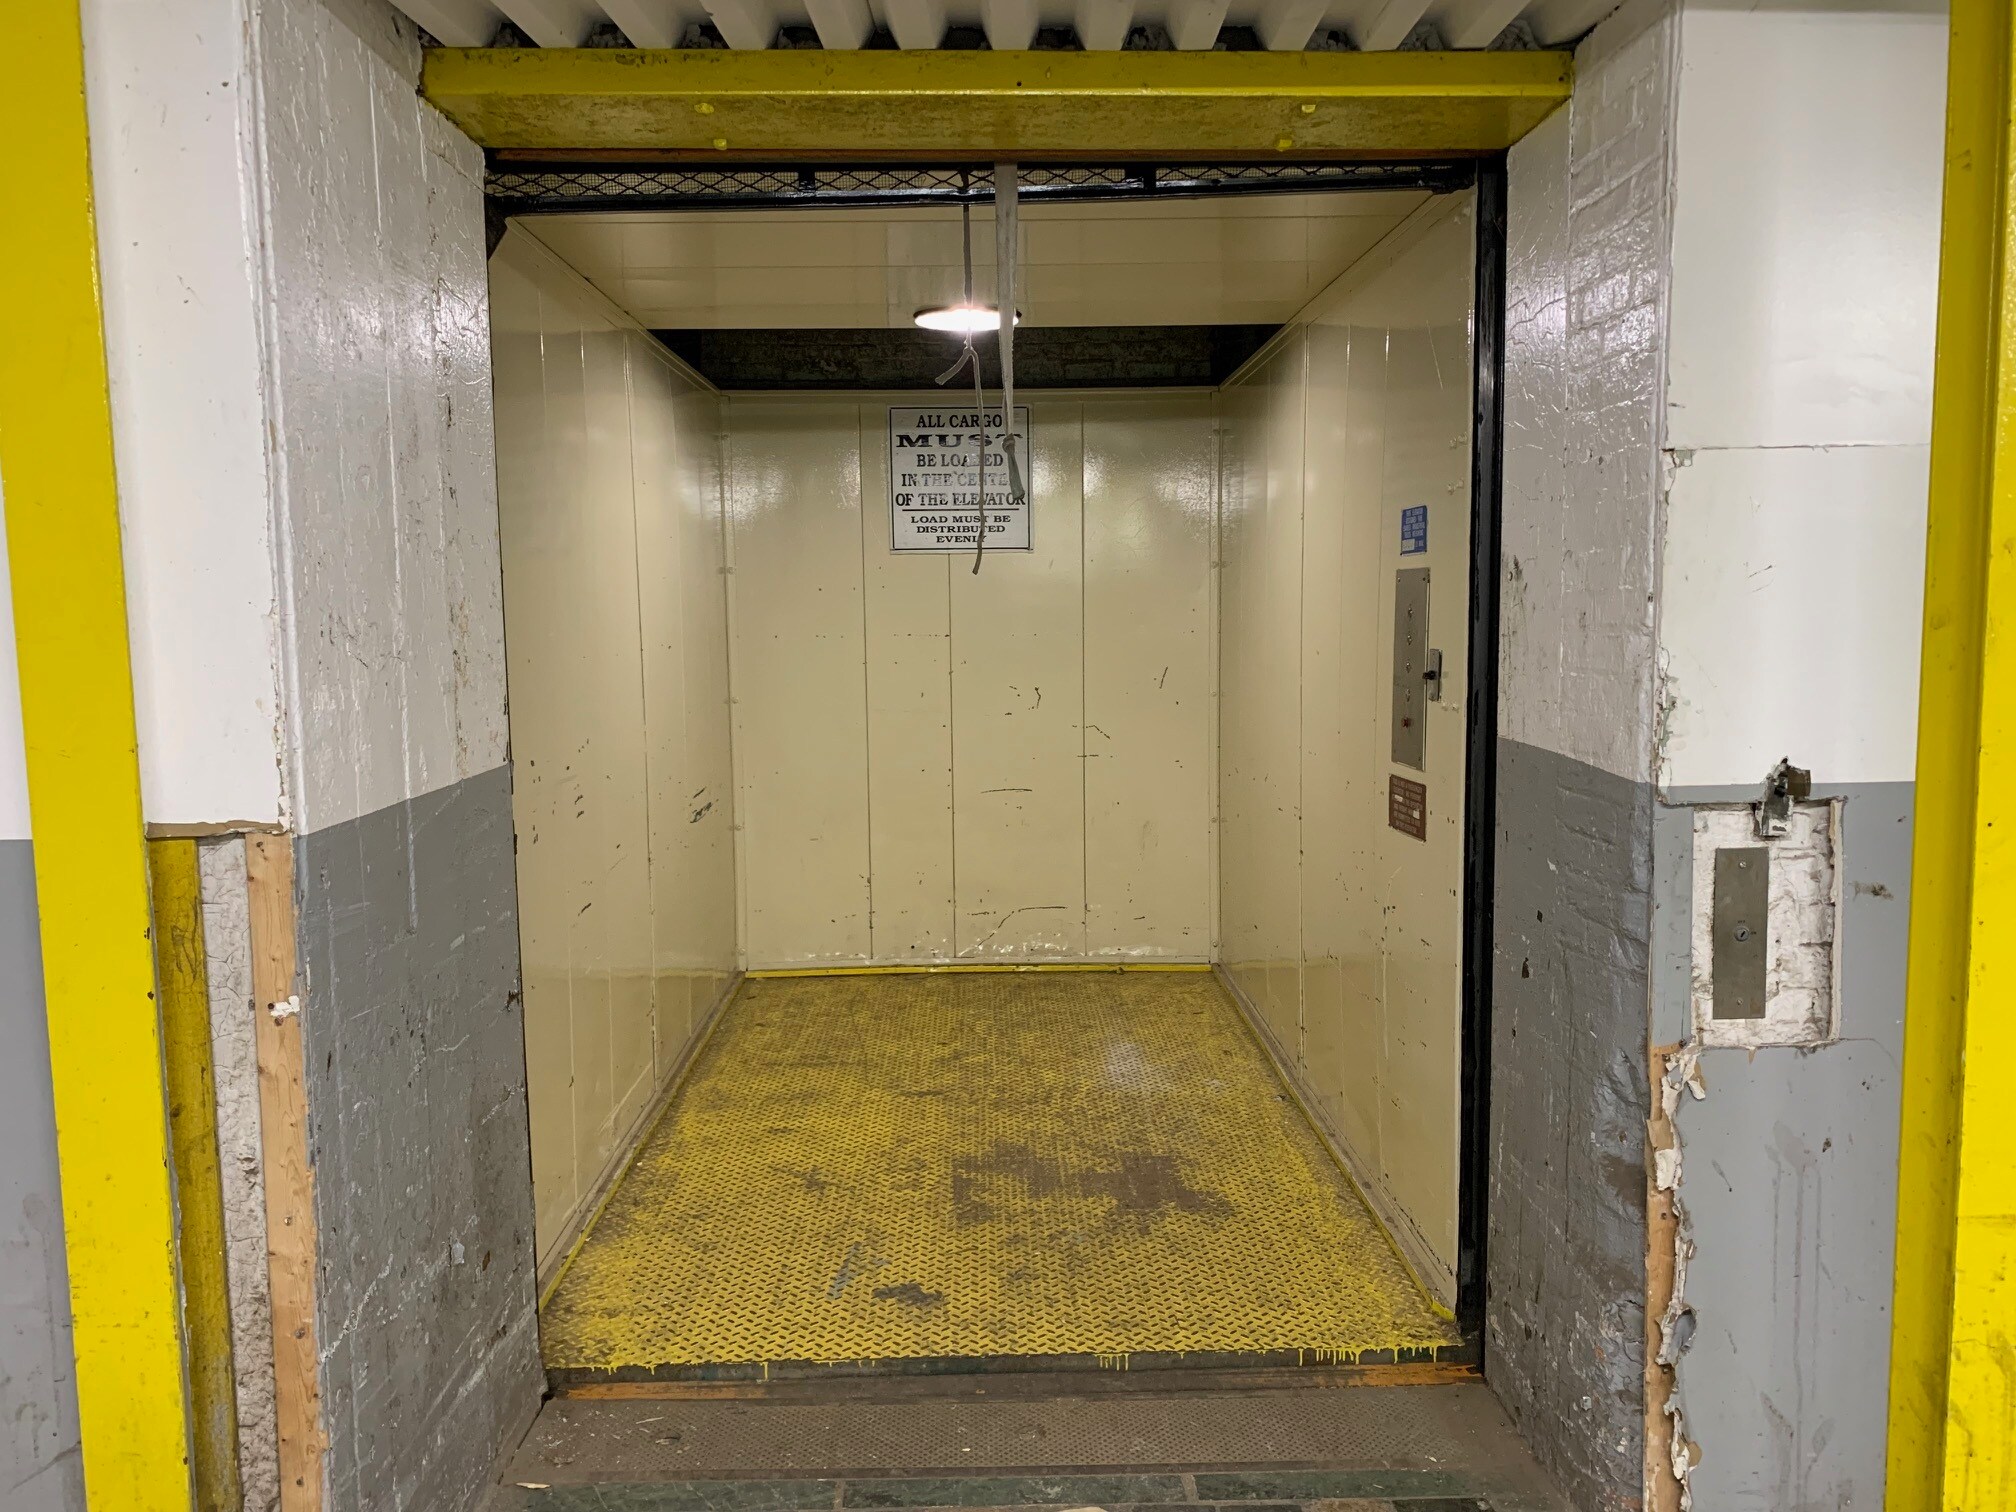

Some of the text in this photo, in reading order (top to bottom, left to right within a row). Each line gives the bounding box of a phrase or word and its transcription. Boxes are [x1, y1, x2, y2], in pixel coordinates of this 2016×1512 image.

[916, 414, 1002, 428] ALL CARGO
[917, 454, 937, 467] BE
[901, 472, 1016, 487] IN THE CENTE
[896, 493, 914, 506] OF
[918, 493, 948, 506] THE
[993, 515, 1011, 523] BE
